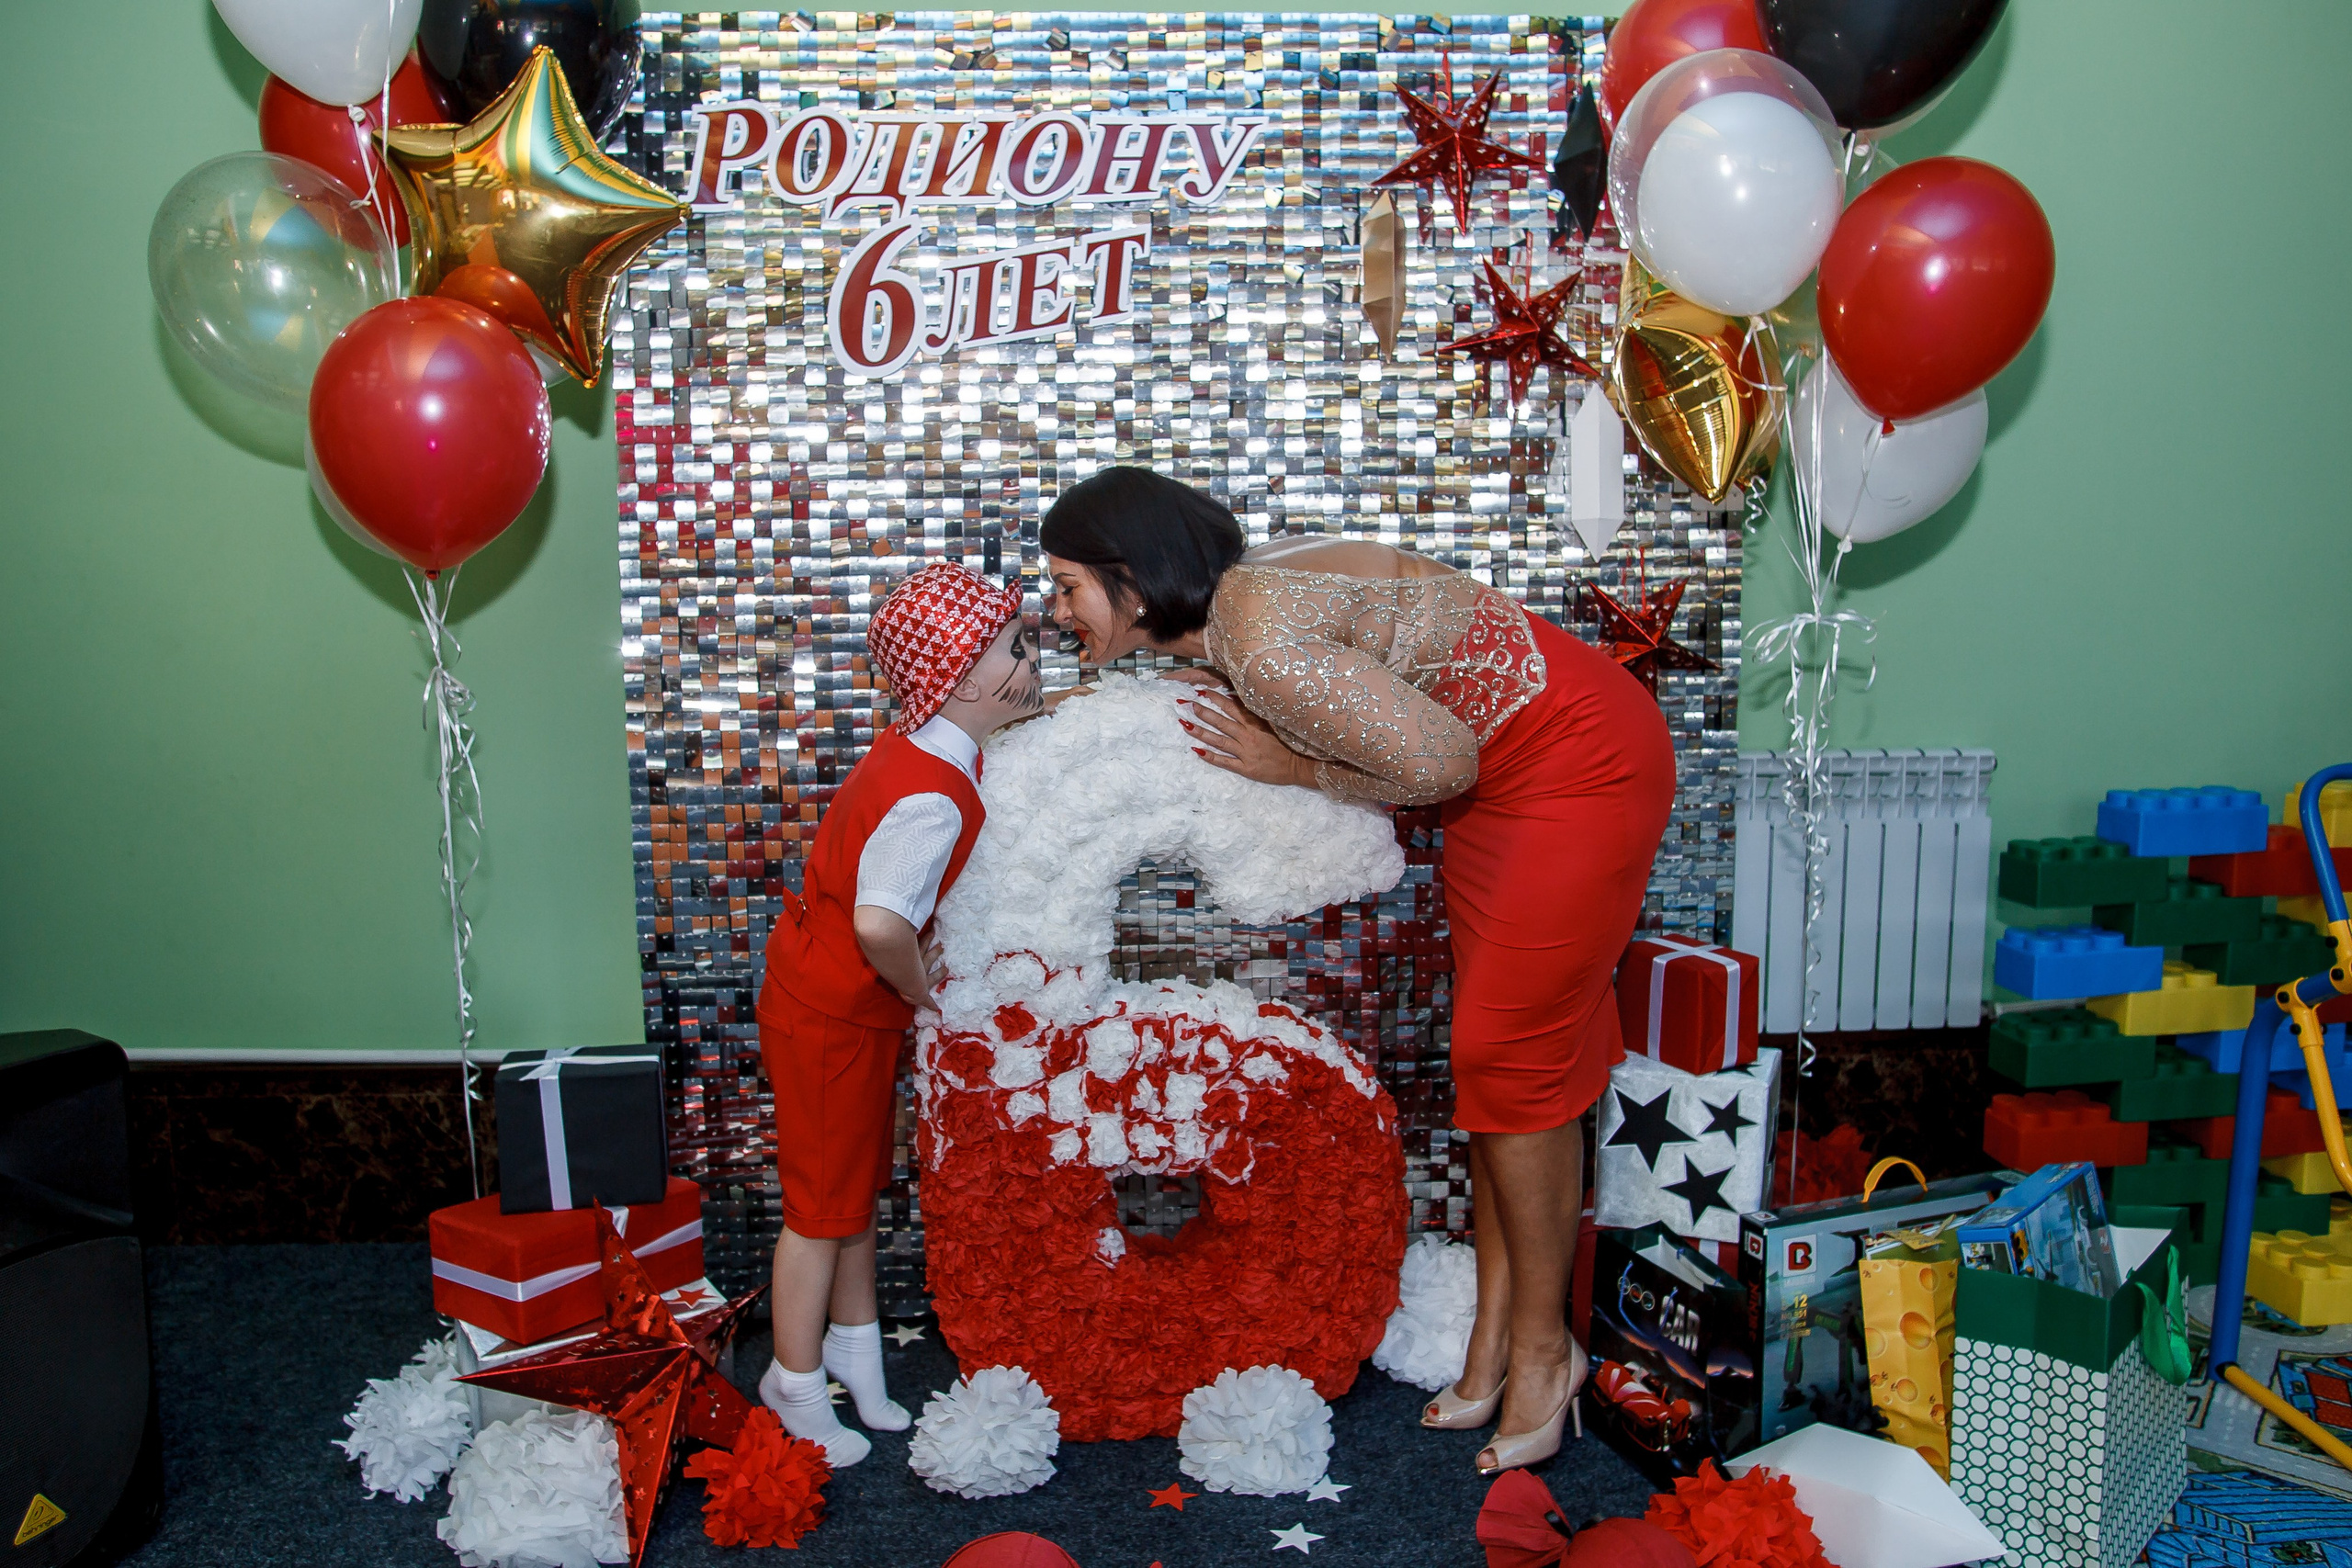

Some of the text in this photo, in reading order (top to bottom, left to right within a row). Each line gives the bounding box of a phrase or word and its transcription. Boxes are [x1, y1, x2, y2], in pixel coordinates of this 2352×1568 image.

[691, 99, 1266, 220] РОДИОНУ
[828, 216, 1152, 376] 6 ЛЕТ
[1788, 1241, 1813, 1271] B
[1658, 1294, 1702, 1354] CAR
